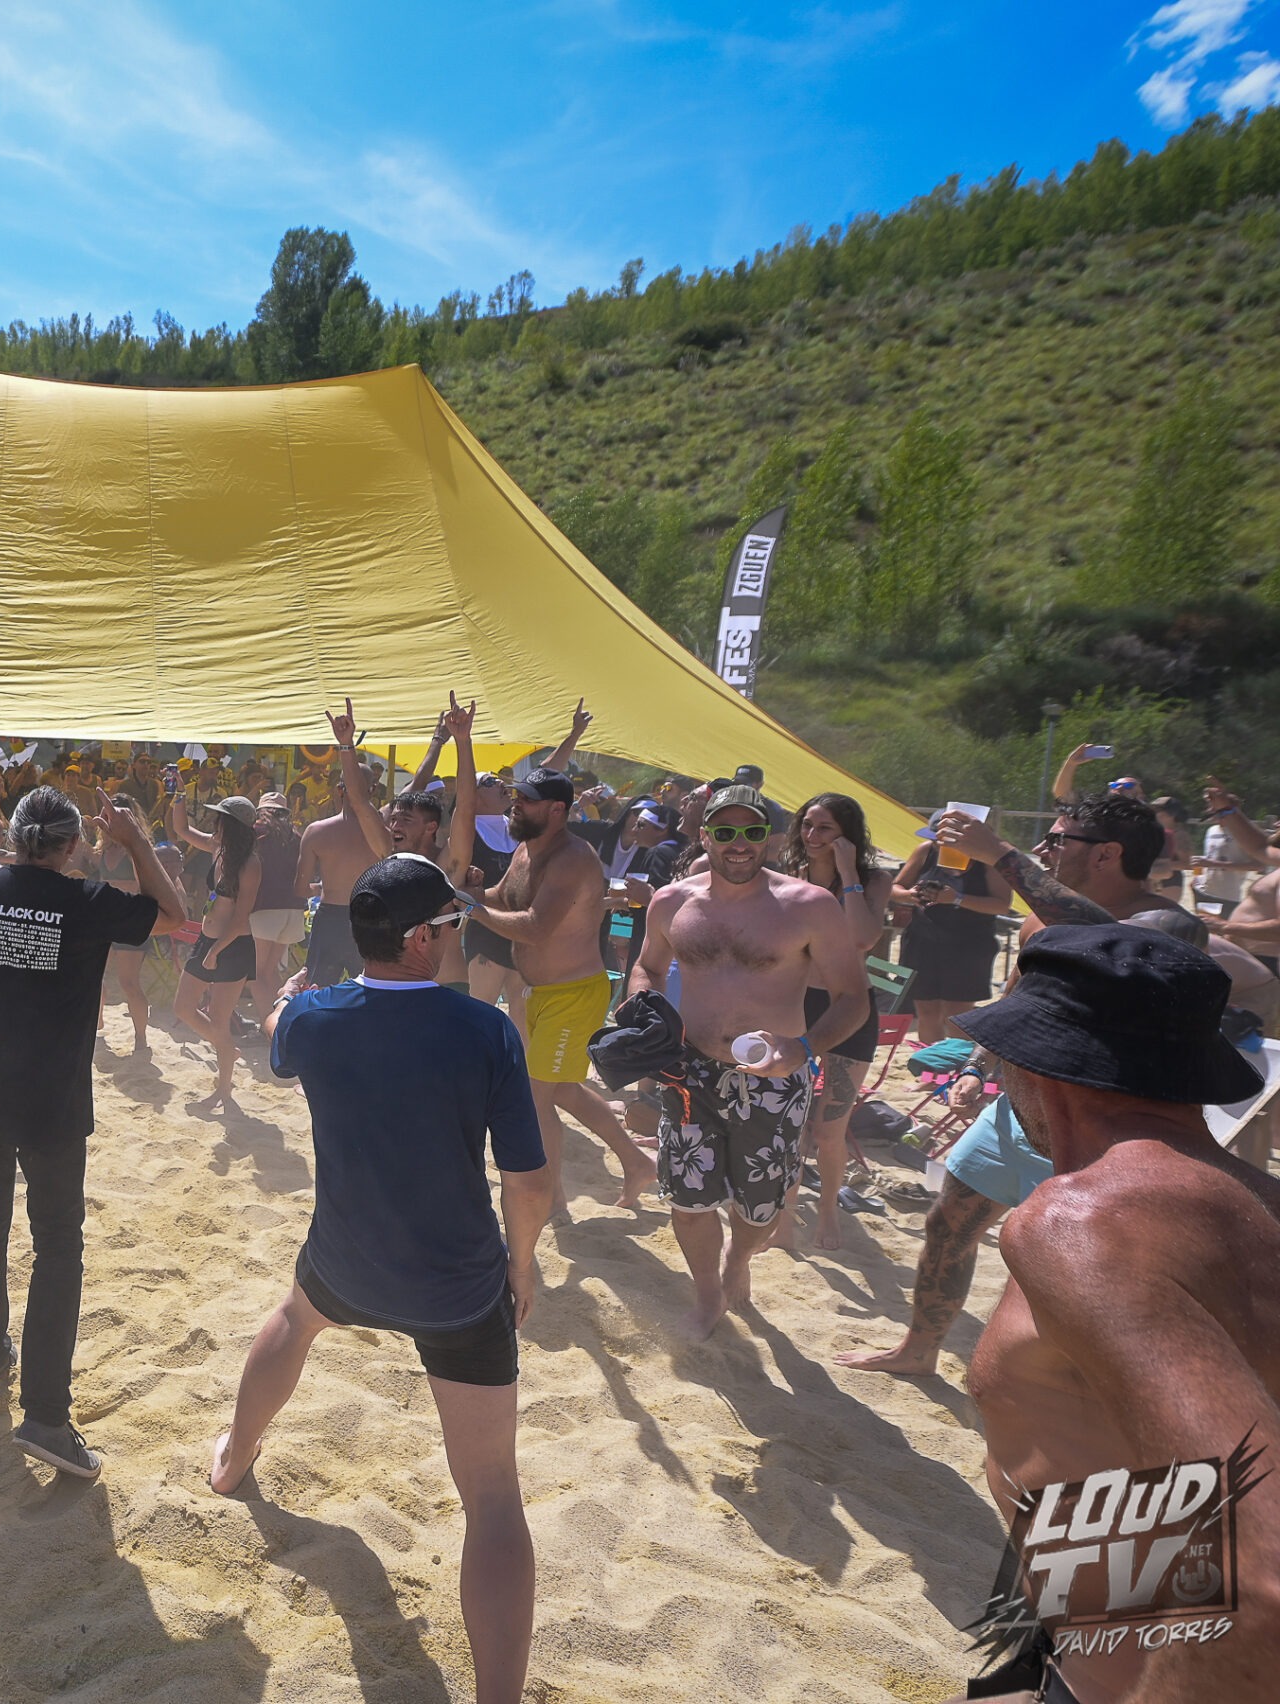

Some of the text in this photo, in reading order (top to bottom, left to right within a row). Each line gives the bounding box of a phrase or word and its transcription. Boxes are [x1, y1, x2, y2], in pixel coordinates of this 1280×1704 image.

[738, 538, 771, 594] ZGUEN
[34, 910, 63, 925] OUT
[551, 1028, 571, 1073] NABAIJI
